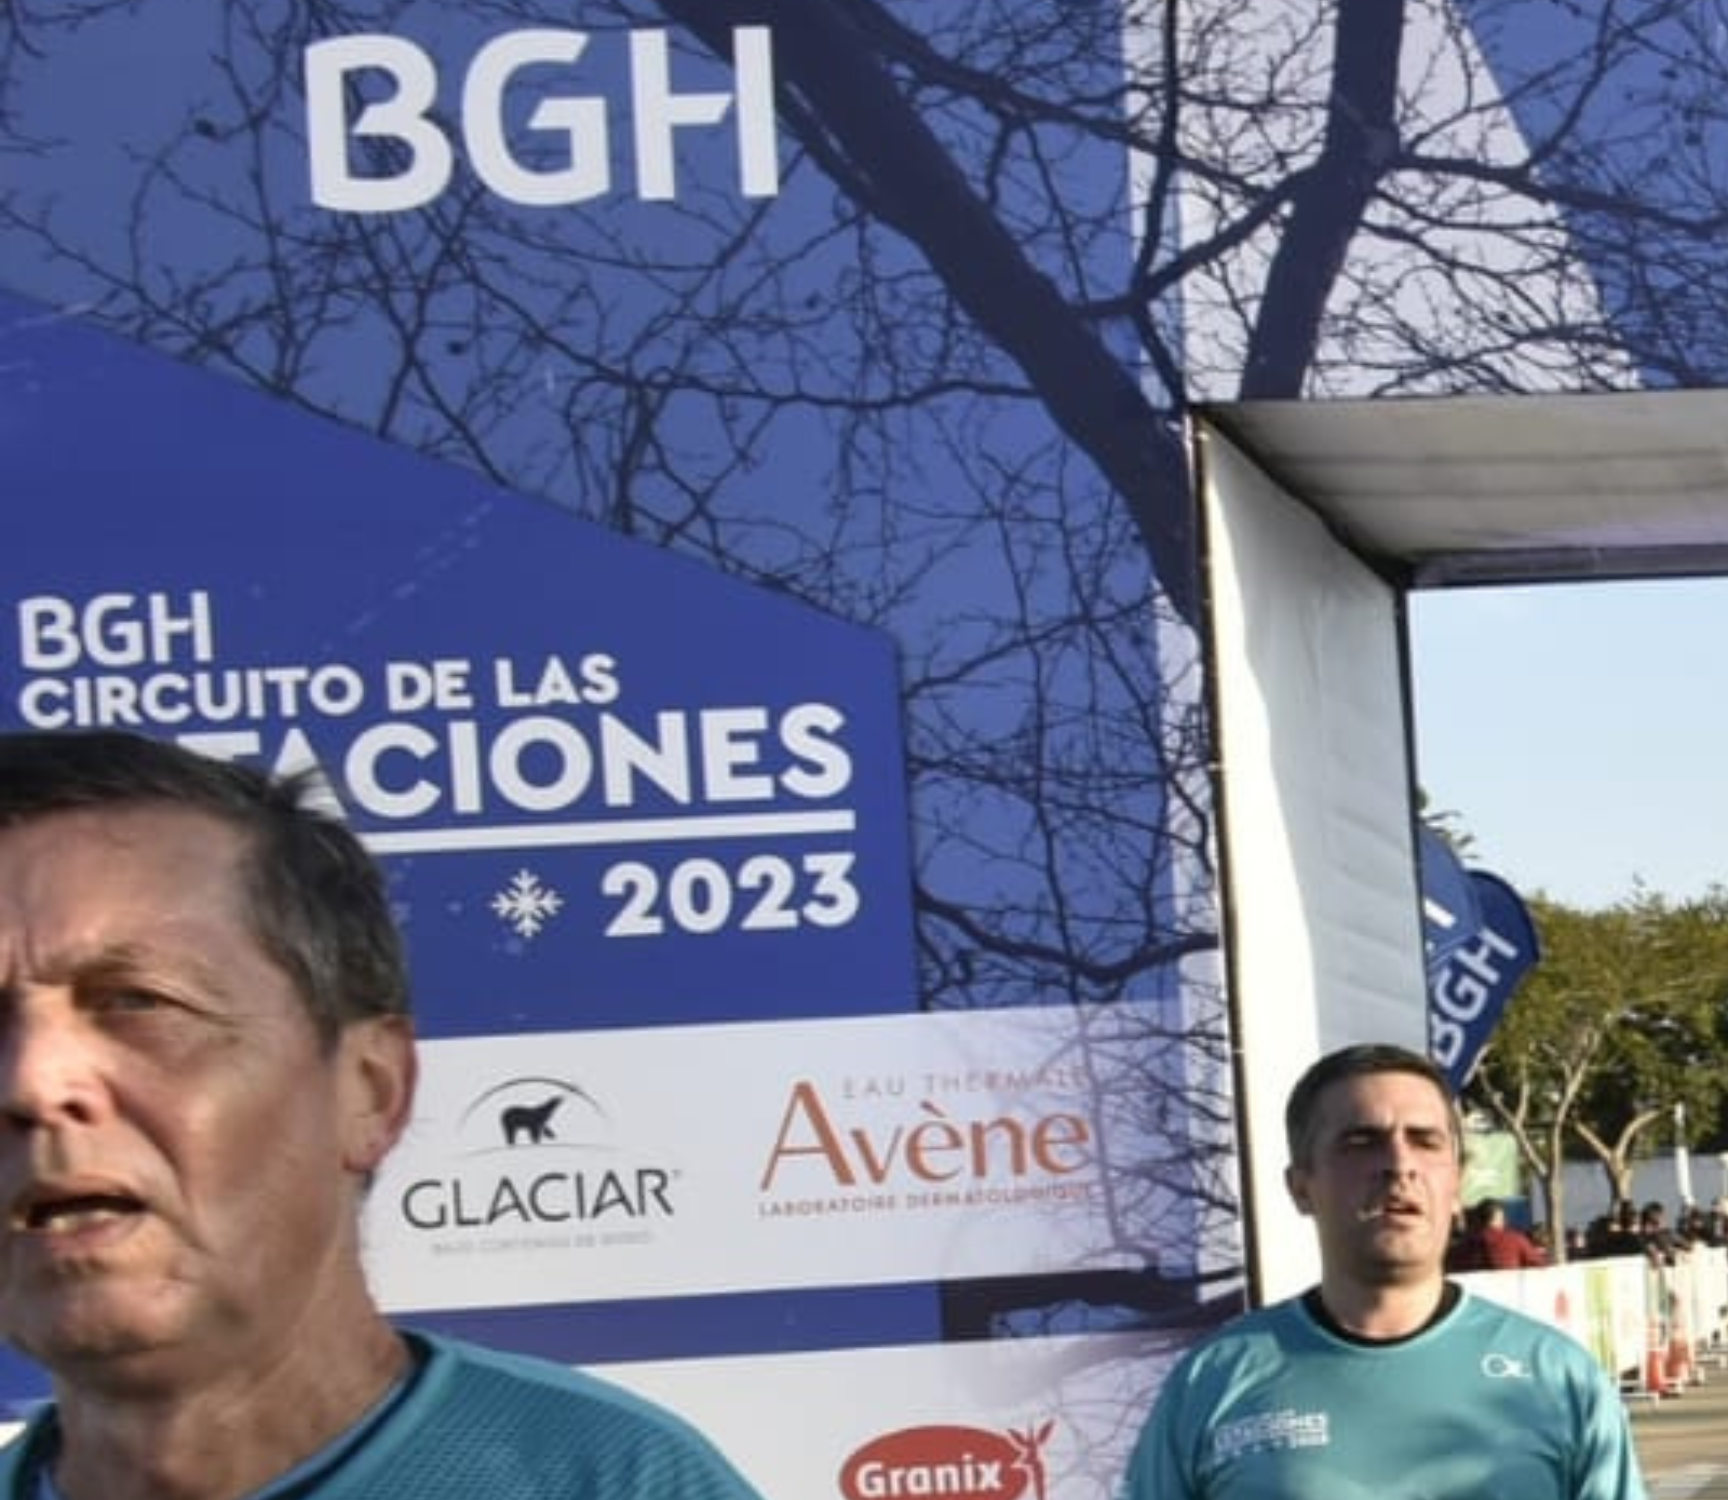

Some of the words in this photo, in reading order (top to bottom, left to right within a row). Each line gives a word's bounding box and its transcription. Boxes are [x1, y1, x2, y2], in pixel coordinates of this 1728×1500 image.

[304, 24, 778, 211] BGH
[18, 592, 212, 668] BGH
[19, 667, 362, 730] CIRCUITO
[387, 659, 473, 712] DE
[495, 653, 620, 707] LAS
[172, 703, 853, 818] ACIONES
[601, 852, 860, 938] 2023
[760, 1080, 1090, 1191] Avène
[401, 1168, 673, 1229] GLACIAR
[855, 1453, 1004, 1499] Granix
